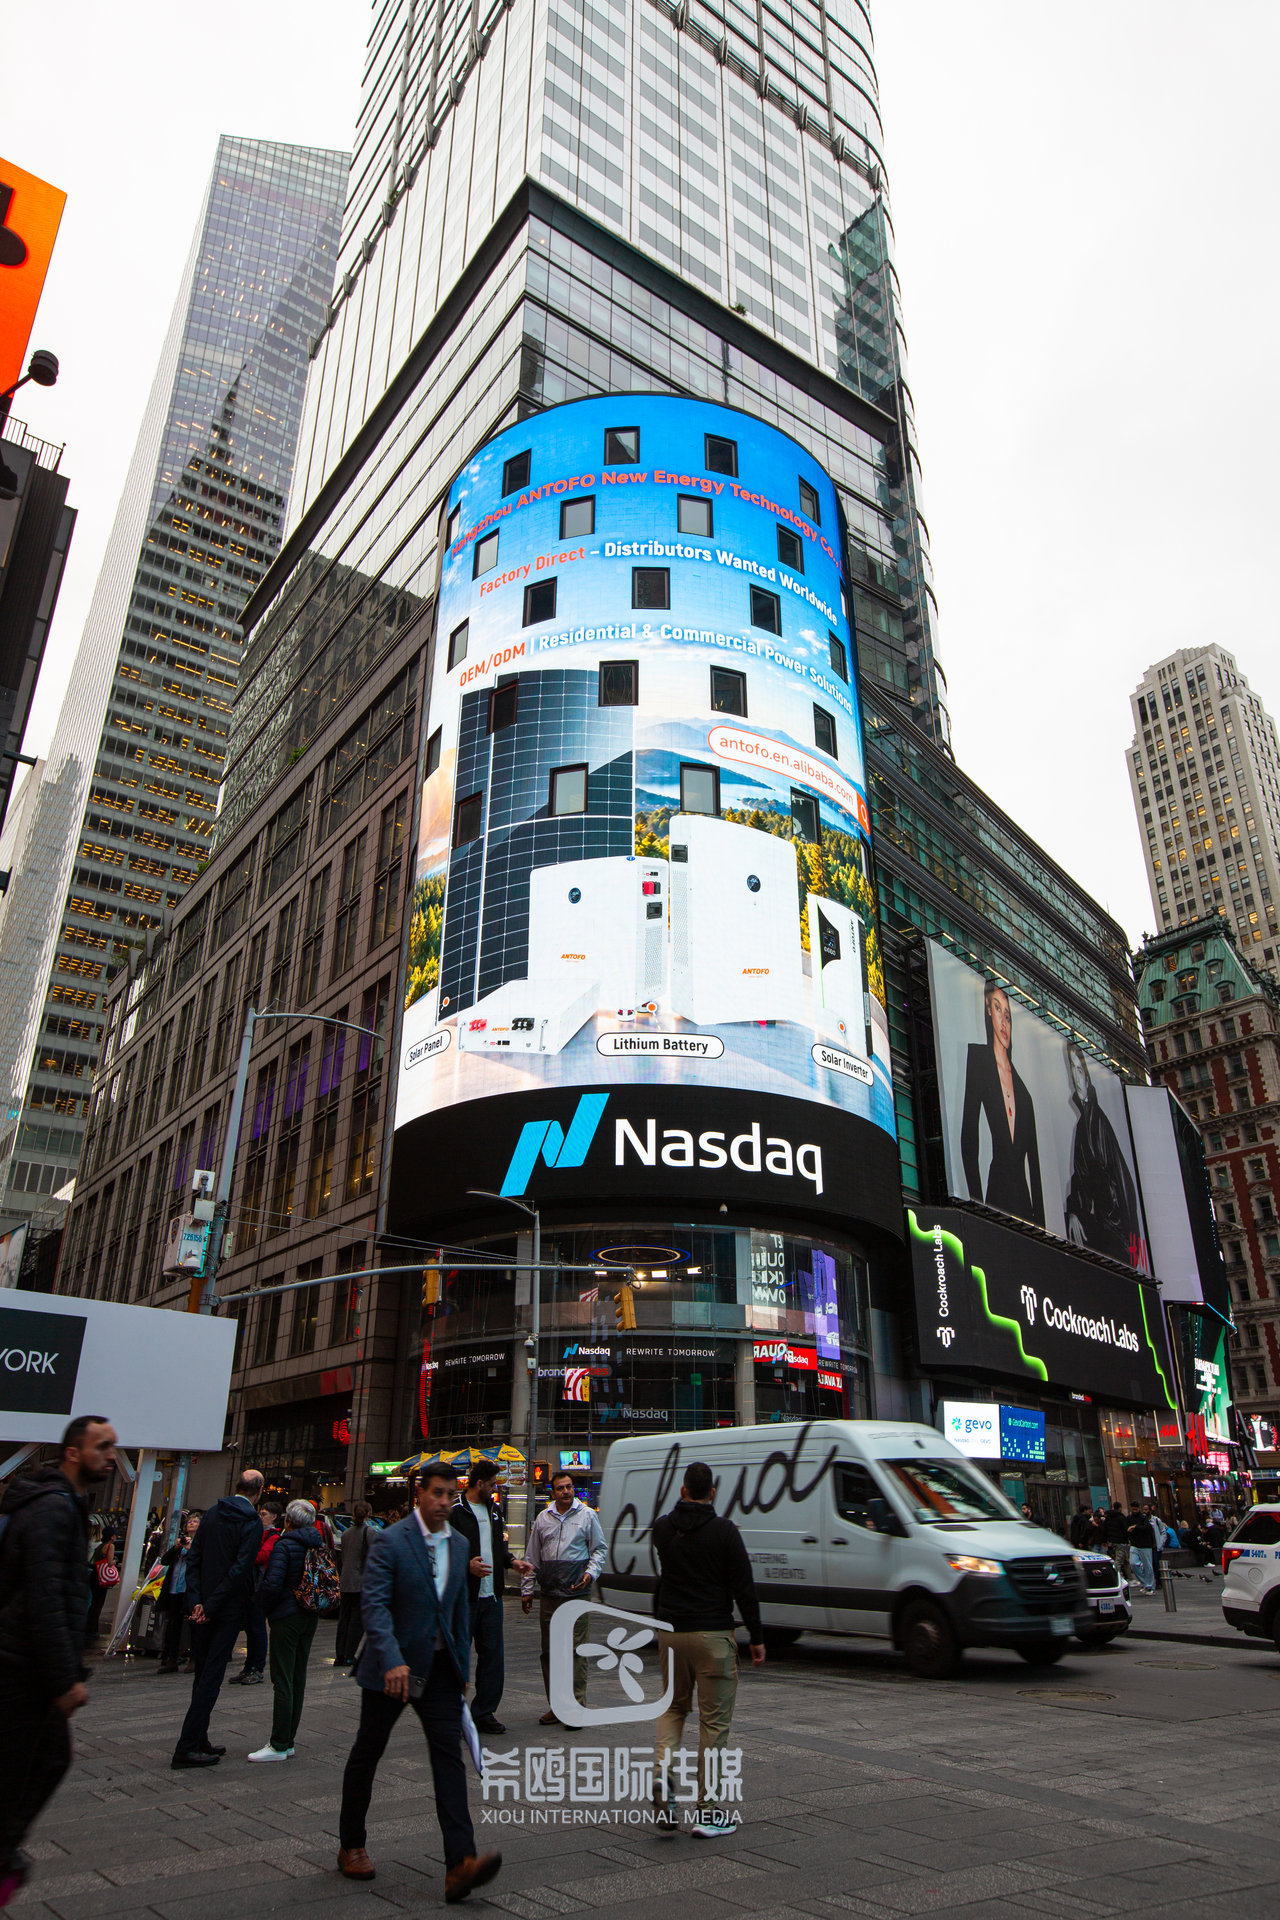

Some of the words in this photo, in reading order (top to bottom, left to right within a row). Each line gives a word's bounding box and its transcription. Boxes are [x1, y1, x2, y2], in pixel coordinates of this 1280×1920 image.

[451, 503, 512, 560] Hangzhou
[516, 474, 596, 509] ANTOFO
[601, 471, 648, 485] New
[654, 470, 725, 495] Energy
[730, 482, 818, 542] Technology
[480, 563, 531, 598] Factory
[535, 546, 586, 571] Direct
[604, 540, 713, 562] Distributors
[715, 549, 776, 582] Wanted
[778, 571, 838, 626] Worldwide
[459, 641, 526, 687] OEM/ODM
[539, 623, 637, 651] Residential
[642, 623, 654, 639] &
[660, 624, 761, 657] Commercial
[765, 645, 809, 676] Power
[809, 667, 853, 716] Solutions
[719, 737, 854, 806] antofo.en.alibaba.com
[561, 953, 586, 961] ANTOFO
[409, 1045, 423, 1063] Solar
[424, 1035, 443, 1054] Panel
[613, 1037, 660, 1050] Lithium
[663, 1039, 709, 1055] Battery
[821, 1050, 842, 1068] Solar
[843, 1058, 869, 1079] Inverter
[614, 1118, 824, 1195] Nasdaq
[932, 1224, 944, 1252] Labs
[934, 1254, 949, 1318] Cockroach
[1042, 1296, 1112, 1345] Cockroach
[1110, 1318, 1140, 1353] Labs
[445, 1356, 467, 1367] REWRITE
[469, 1352, 506, 1364] TOMORROW
[578, 1346, 611, 1357] Nasdaq
[626, 1348, 664, 1356] REWRITE
[668, 1348, 716, 1357] TOMORROW
[784, 1353, 809, 1366] Nasdaq
[622, 1408, 669, 1421] Nasdaq
[965, 1418, 993, 1433] gevo
